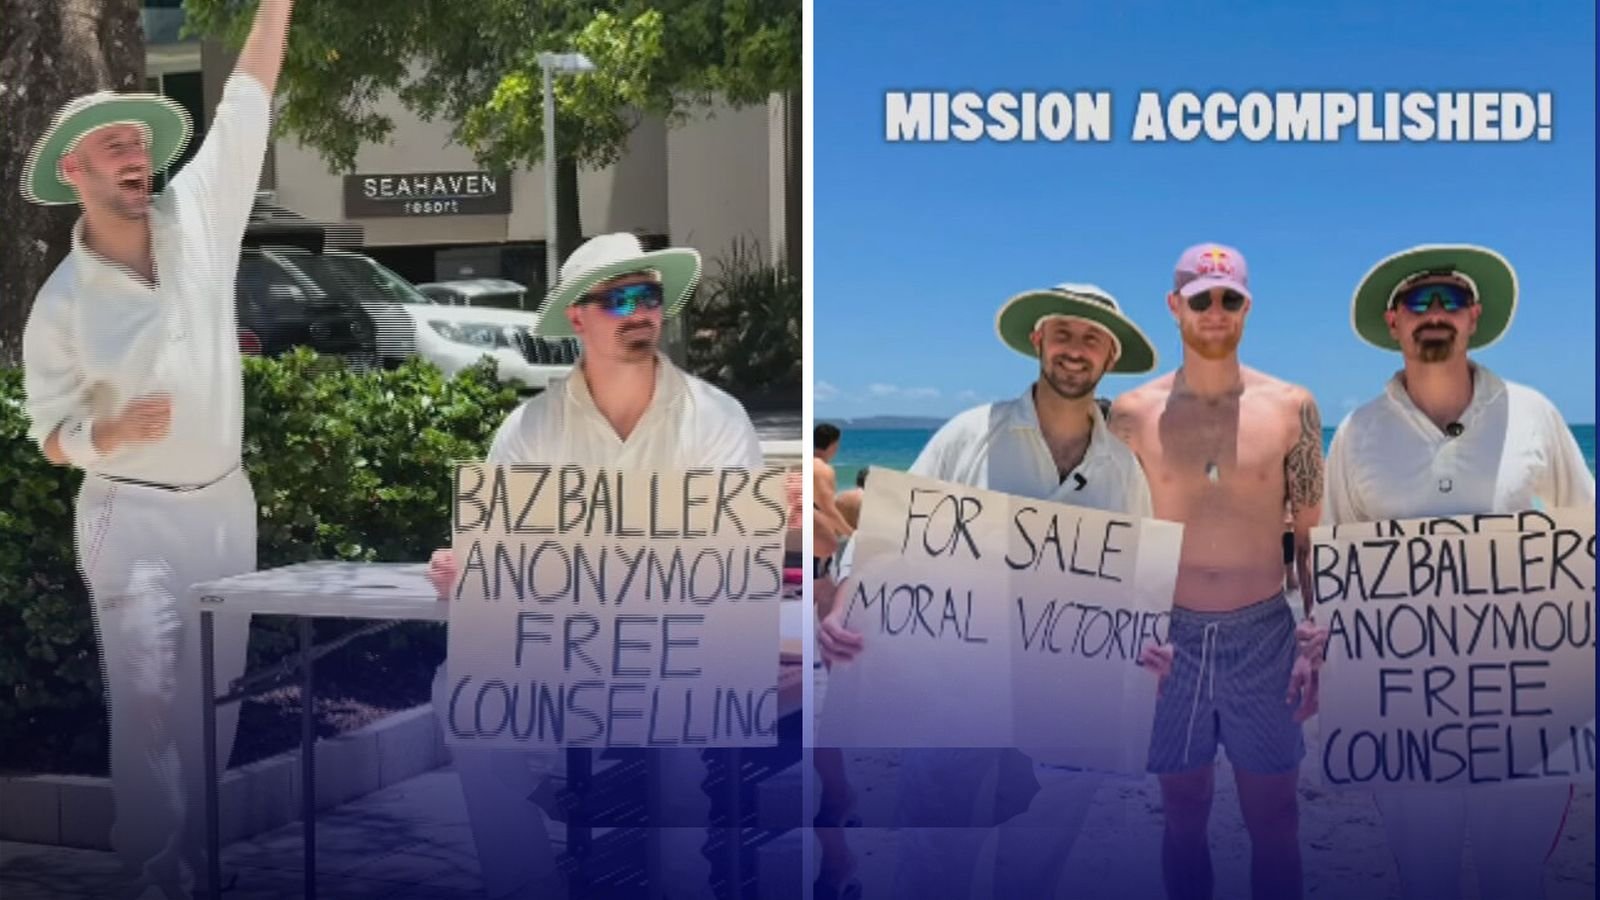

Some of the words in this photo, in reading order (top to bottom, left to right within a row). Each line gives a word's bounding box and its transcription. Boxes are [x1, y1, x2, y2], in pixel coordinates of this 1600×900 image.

[363, 174, 497, 198] SEAHAVEN
[404, 200, 460, 214] resort
[454, 464, 787, 538] BAZBALLERS
[901, 487, 983, 561] FOR
[1004, 506, 1133, 583] SALE
[456, 540, 781, 606] ANONYMOUS
[843, 580, 989, 644] MORAL
[1321, 601, 1596, 662] ANONYMOU
[515, 611, 706, 680] FREE
[449, 675, 778, 748] COUNSELLING
[1379, 660, 1553, 718] FREE
